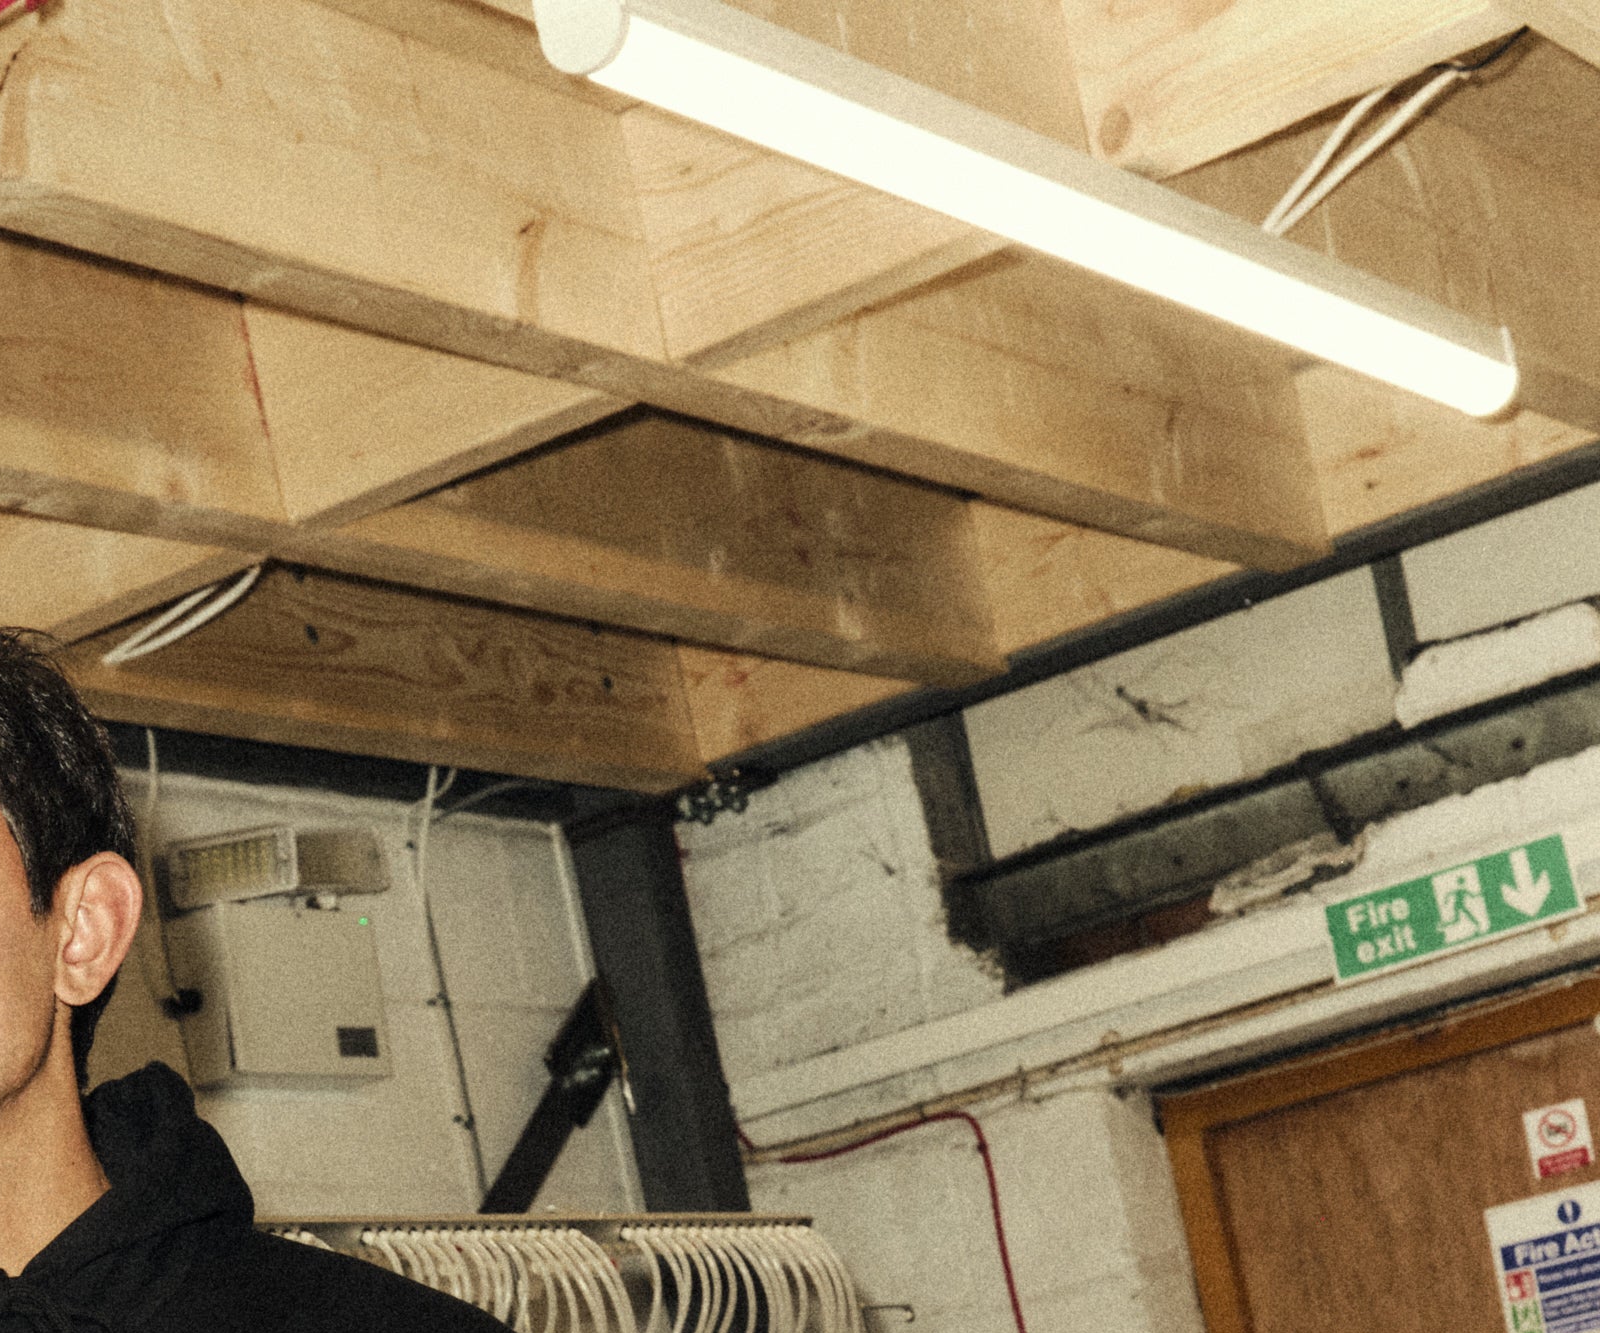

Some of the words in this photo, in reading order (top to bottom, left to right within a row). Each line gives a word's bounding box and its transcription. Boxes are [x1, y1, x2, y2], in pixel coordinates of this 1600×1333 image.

[1346, 898, 1410, 934] Fire
[1356, 924, 1417, 963] exit
[1513, 1240, 1560, 1267] Fire
